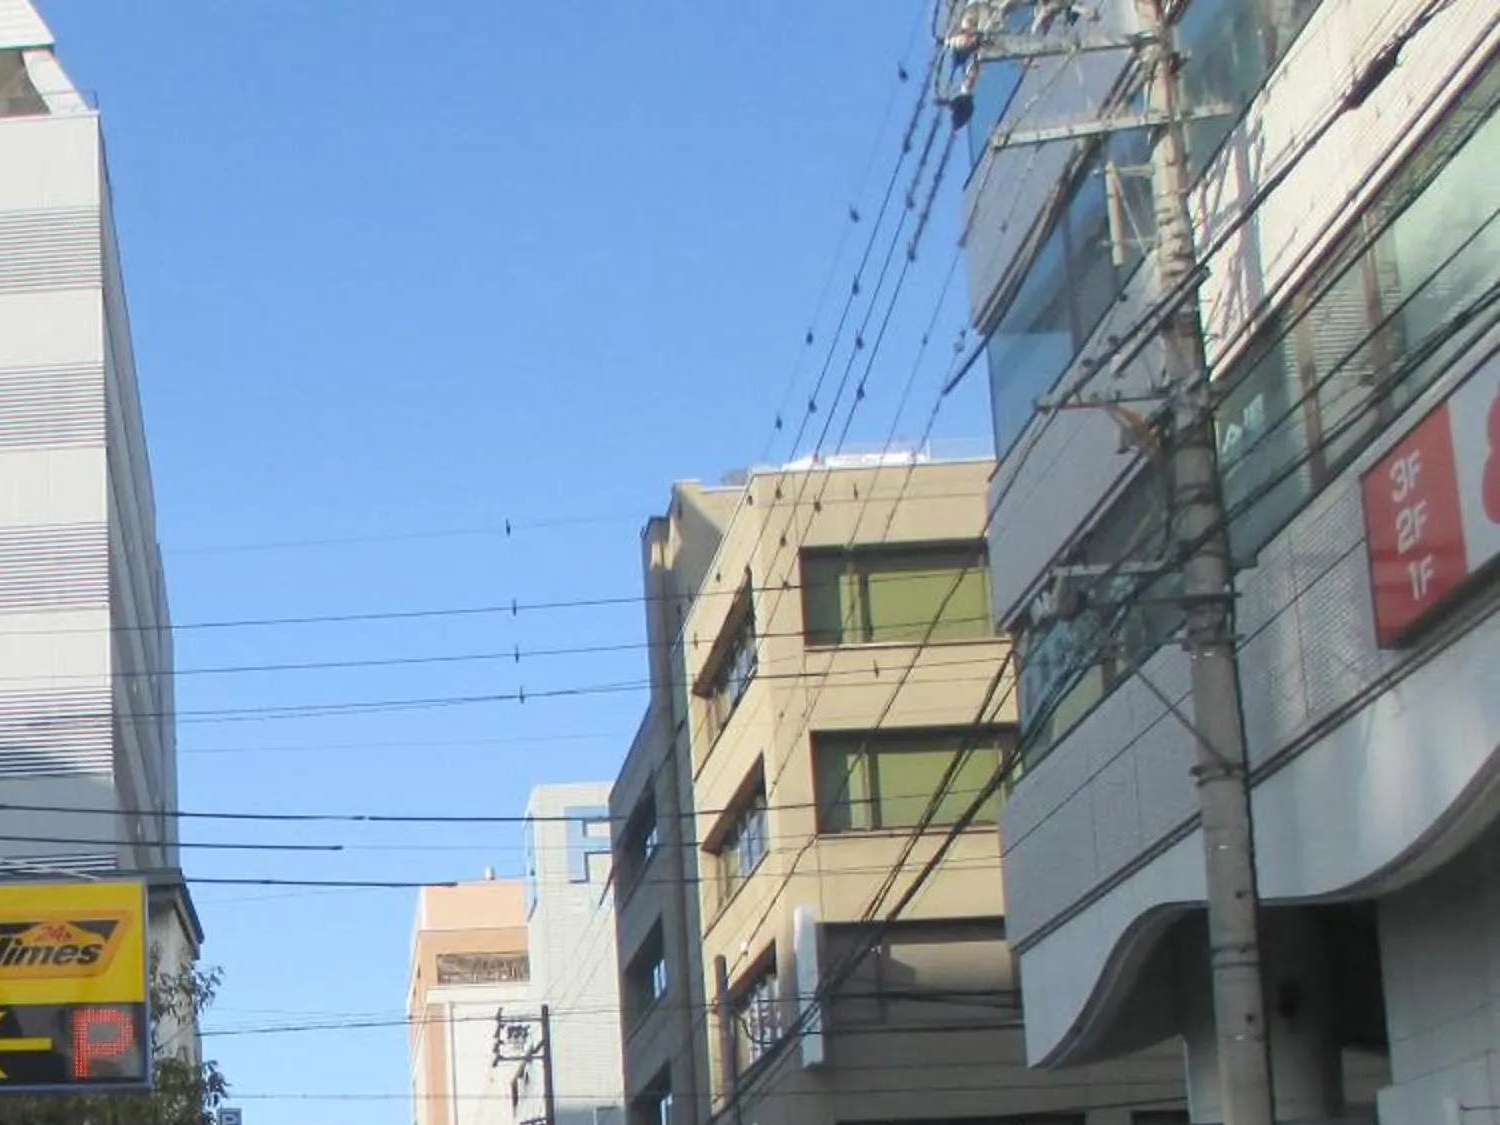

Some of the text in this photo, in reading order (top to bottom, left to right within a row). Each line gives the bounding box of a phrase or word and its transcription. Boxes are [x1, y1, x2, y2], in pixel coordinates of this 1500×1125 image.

[1390, 449, 1421, 502] 3F
[1396, 499, 1428, 555] 2F
[1408, 555, 1434, 601] 1F
[71, 1008, 135, 1079] P
